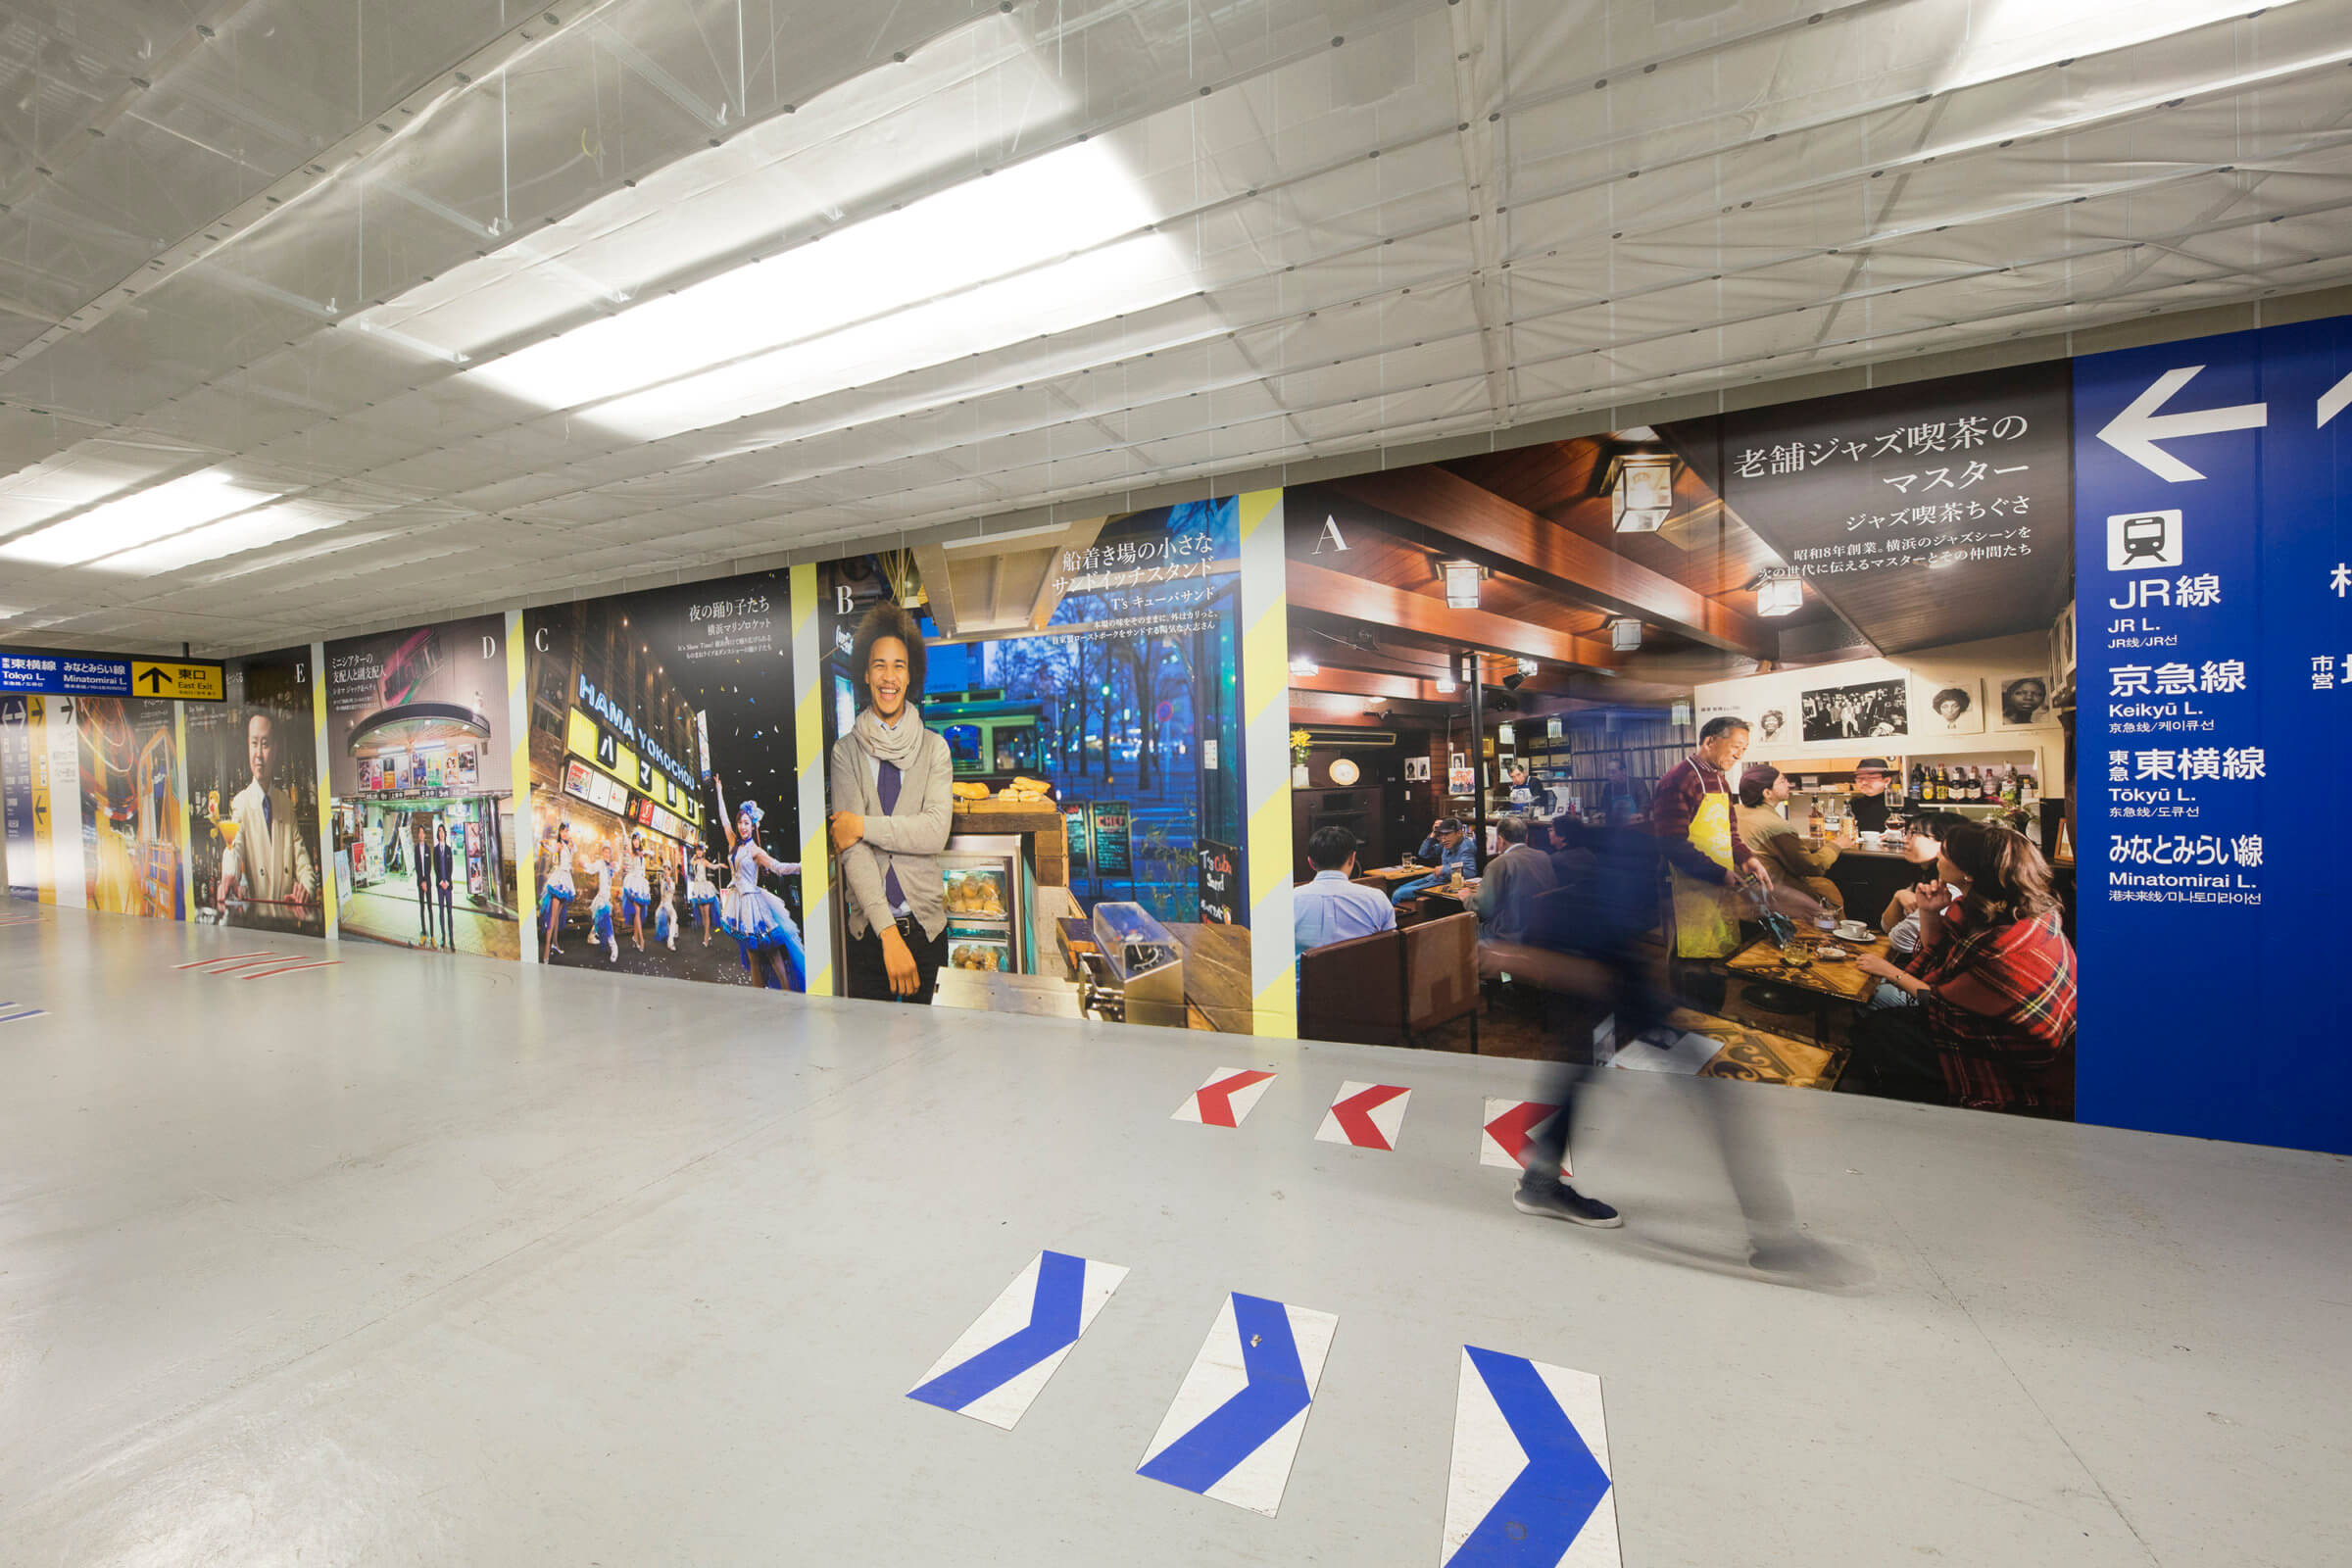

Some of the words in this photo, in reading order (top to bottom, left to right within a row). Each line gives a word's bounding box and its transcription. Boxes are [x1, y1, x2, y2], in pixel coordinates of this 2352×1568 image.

[1733, 416, 2029, 478] 老舗ジャズ喫茶の
[1883, 461, 2029, 494] マスター
[1846, 495, 2031, 531] ジャズ喫茶ちぐさ
[1310, 514, 1352, 555] A
[1793, 525, 2032, 562] 昭和8年創業。横浜のジャズシーンを
[1062, 533, 1213, 572] 船着き場の小さな
[1052, 556, 1214, 596] サンドイッチスタンド
[835, 585, 854, 614] B
[1133, 586, 1215, 609] キューバサンド
[2109, 573, 2221, 610] JR線
[689, 596, 769, 623] 夜の踊り子たち
[2108, 618, 2135, 633] JR
[2142, 617, 2161, 631] L.
[482, 636, 496, 660] D
[535, 628, 549, 652] C
[63, 662, 126, 676] みなとみらい線
[63, 674, 118, 685] Minatomirai
[178, 668, 206, 680] 東口
[296, 663, 306, 684] E
[332, 664, 387, 684] 支配人と副支配人
[2109, 660, 2247, 697] 京急線
[579, 673, 635, 742] HAMA
[2109, 703, 2178, 719] Keikyū
[2184, 702, 2203, 715] L.
[2134, 746, 2267, 781] 東横線
[2178, 788, 2196, 802] L.
[2109, 834, 2264, 867] みなとみらい線
[2109, 872, 2230, 888] Minatomirai
[2237, 874, 2257, 888] L.
